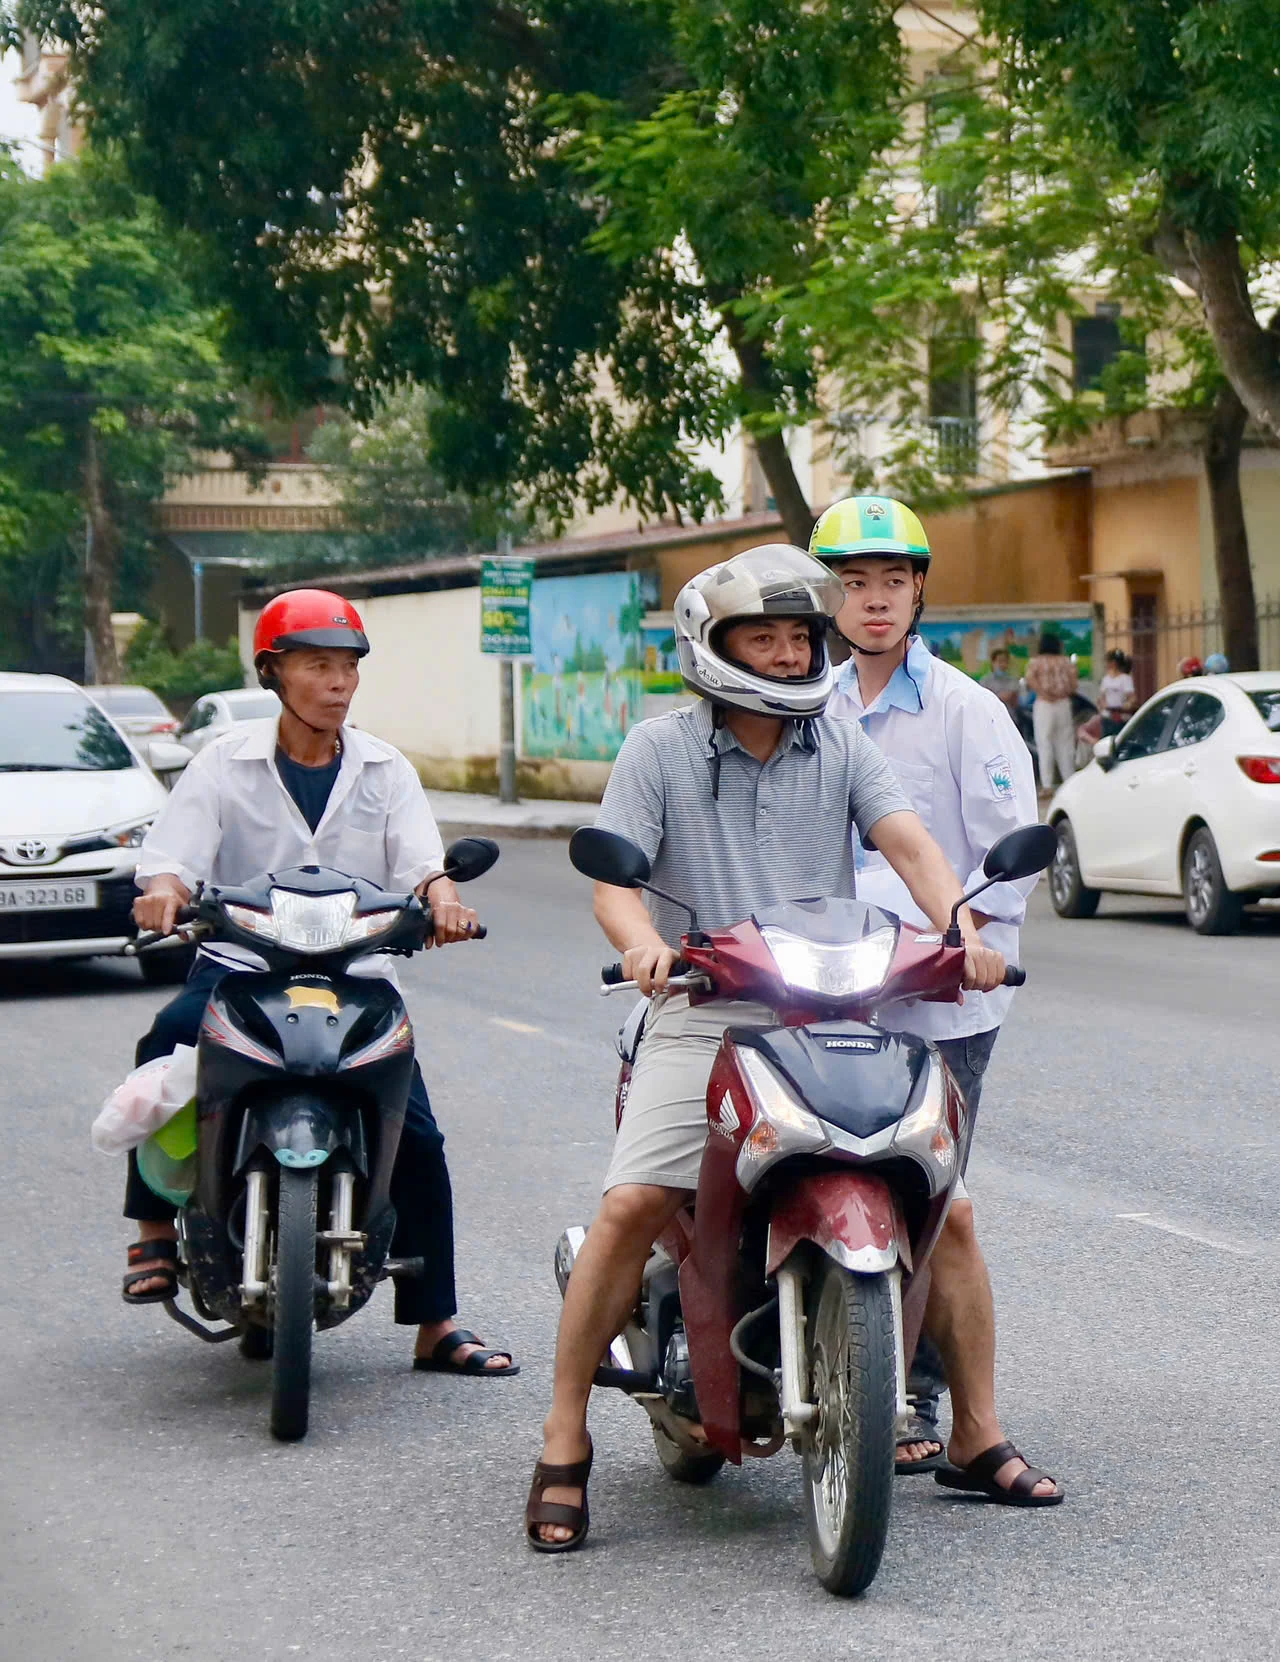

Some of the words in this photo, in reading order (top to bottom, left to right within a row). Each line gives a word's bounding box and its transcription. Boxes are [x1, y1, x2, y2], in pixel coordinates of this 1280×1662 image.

[289, 973, 332, 982] HONDA
[825, 1040, 876, 1050] HONDA
[709, 1118, 735, 1143] HONDA
